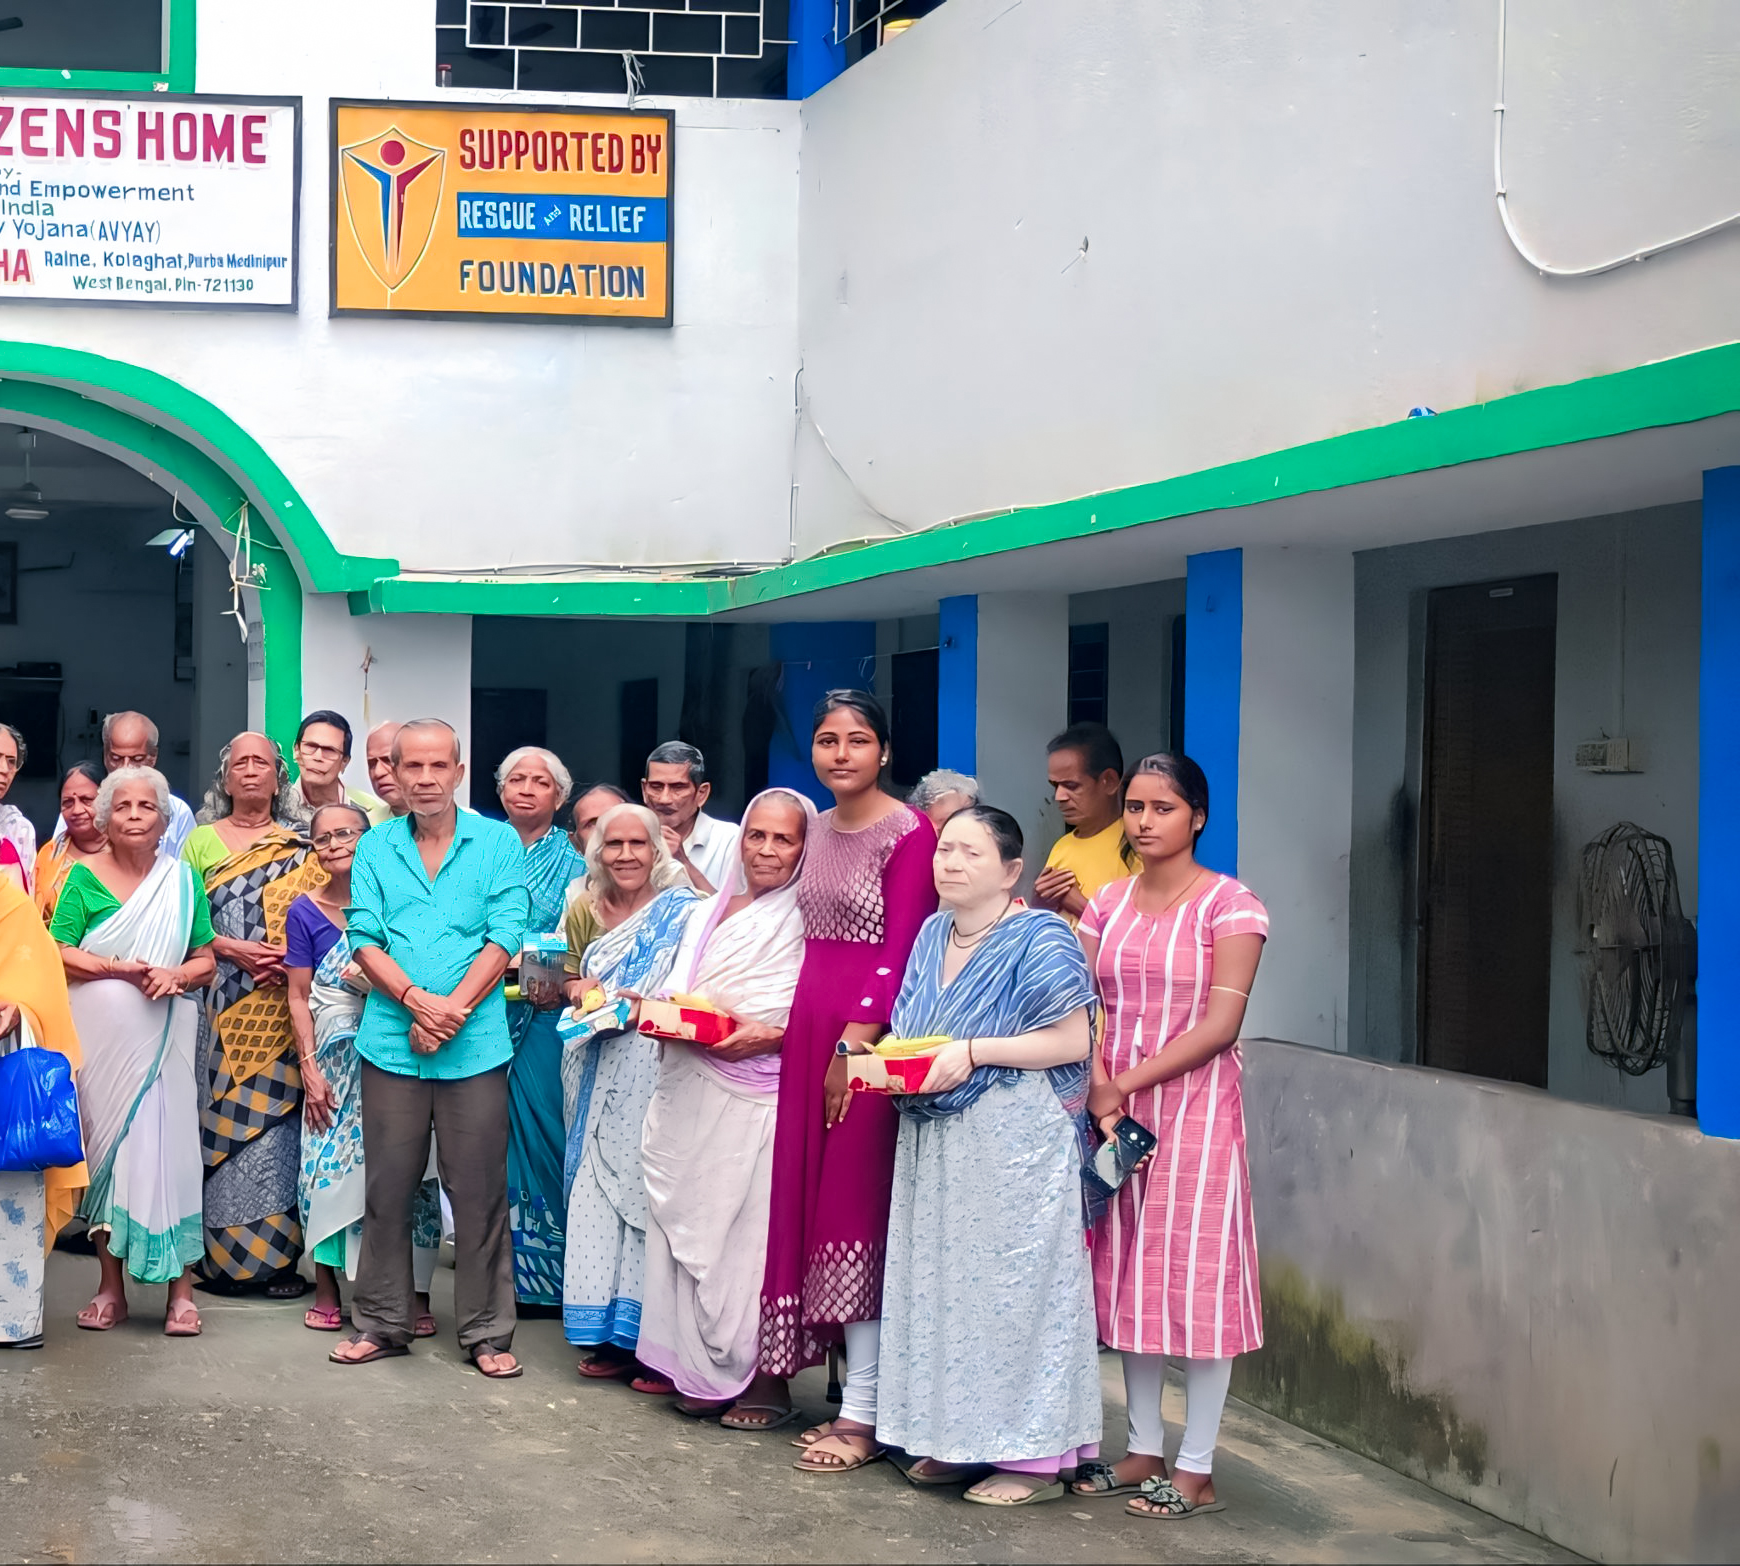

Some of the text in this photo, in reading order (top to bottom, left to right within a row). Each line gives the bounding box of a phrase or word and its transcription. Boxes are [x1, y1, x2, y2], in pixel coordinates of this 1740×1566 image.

[137, 111, 268, 164] HOME
[459, 128, 661, 174] SUPPORTED BY
[30, 181, 195, 201] Empowerment
[1, 199, 55, 216] India
[460, 200, 536, 230] RESCUE
[570, 204, 646, 233] RELIEF
[227, 254, 287, 271] Medinipur
[73, 275, 111, 290] West
[460, 259, 645, 299] FOUNDATION
